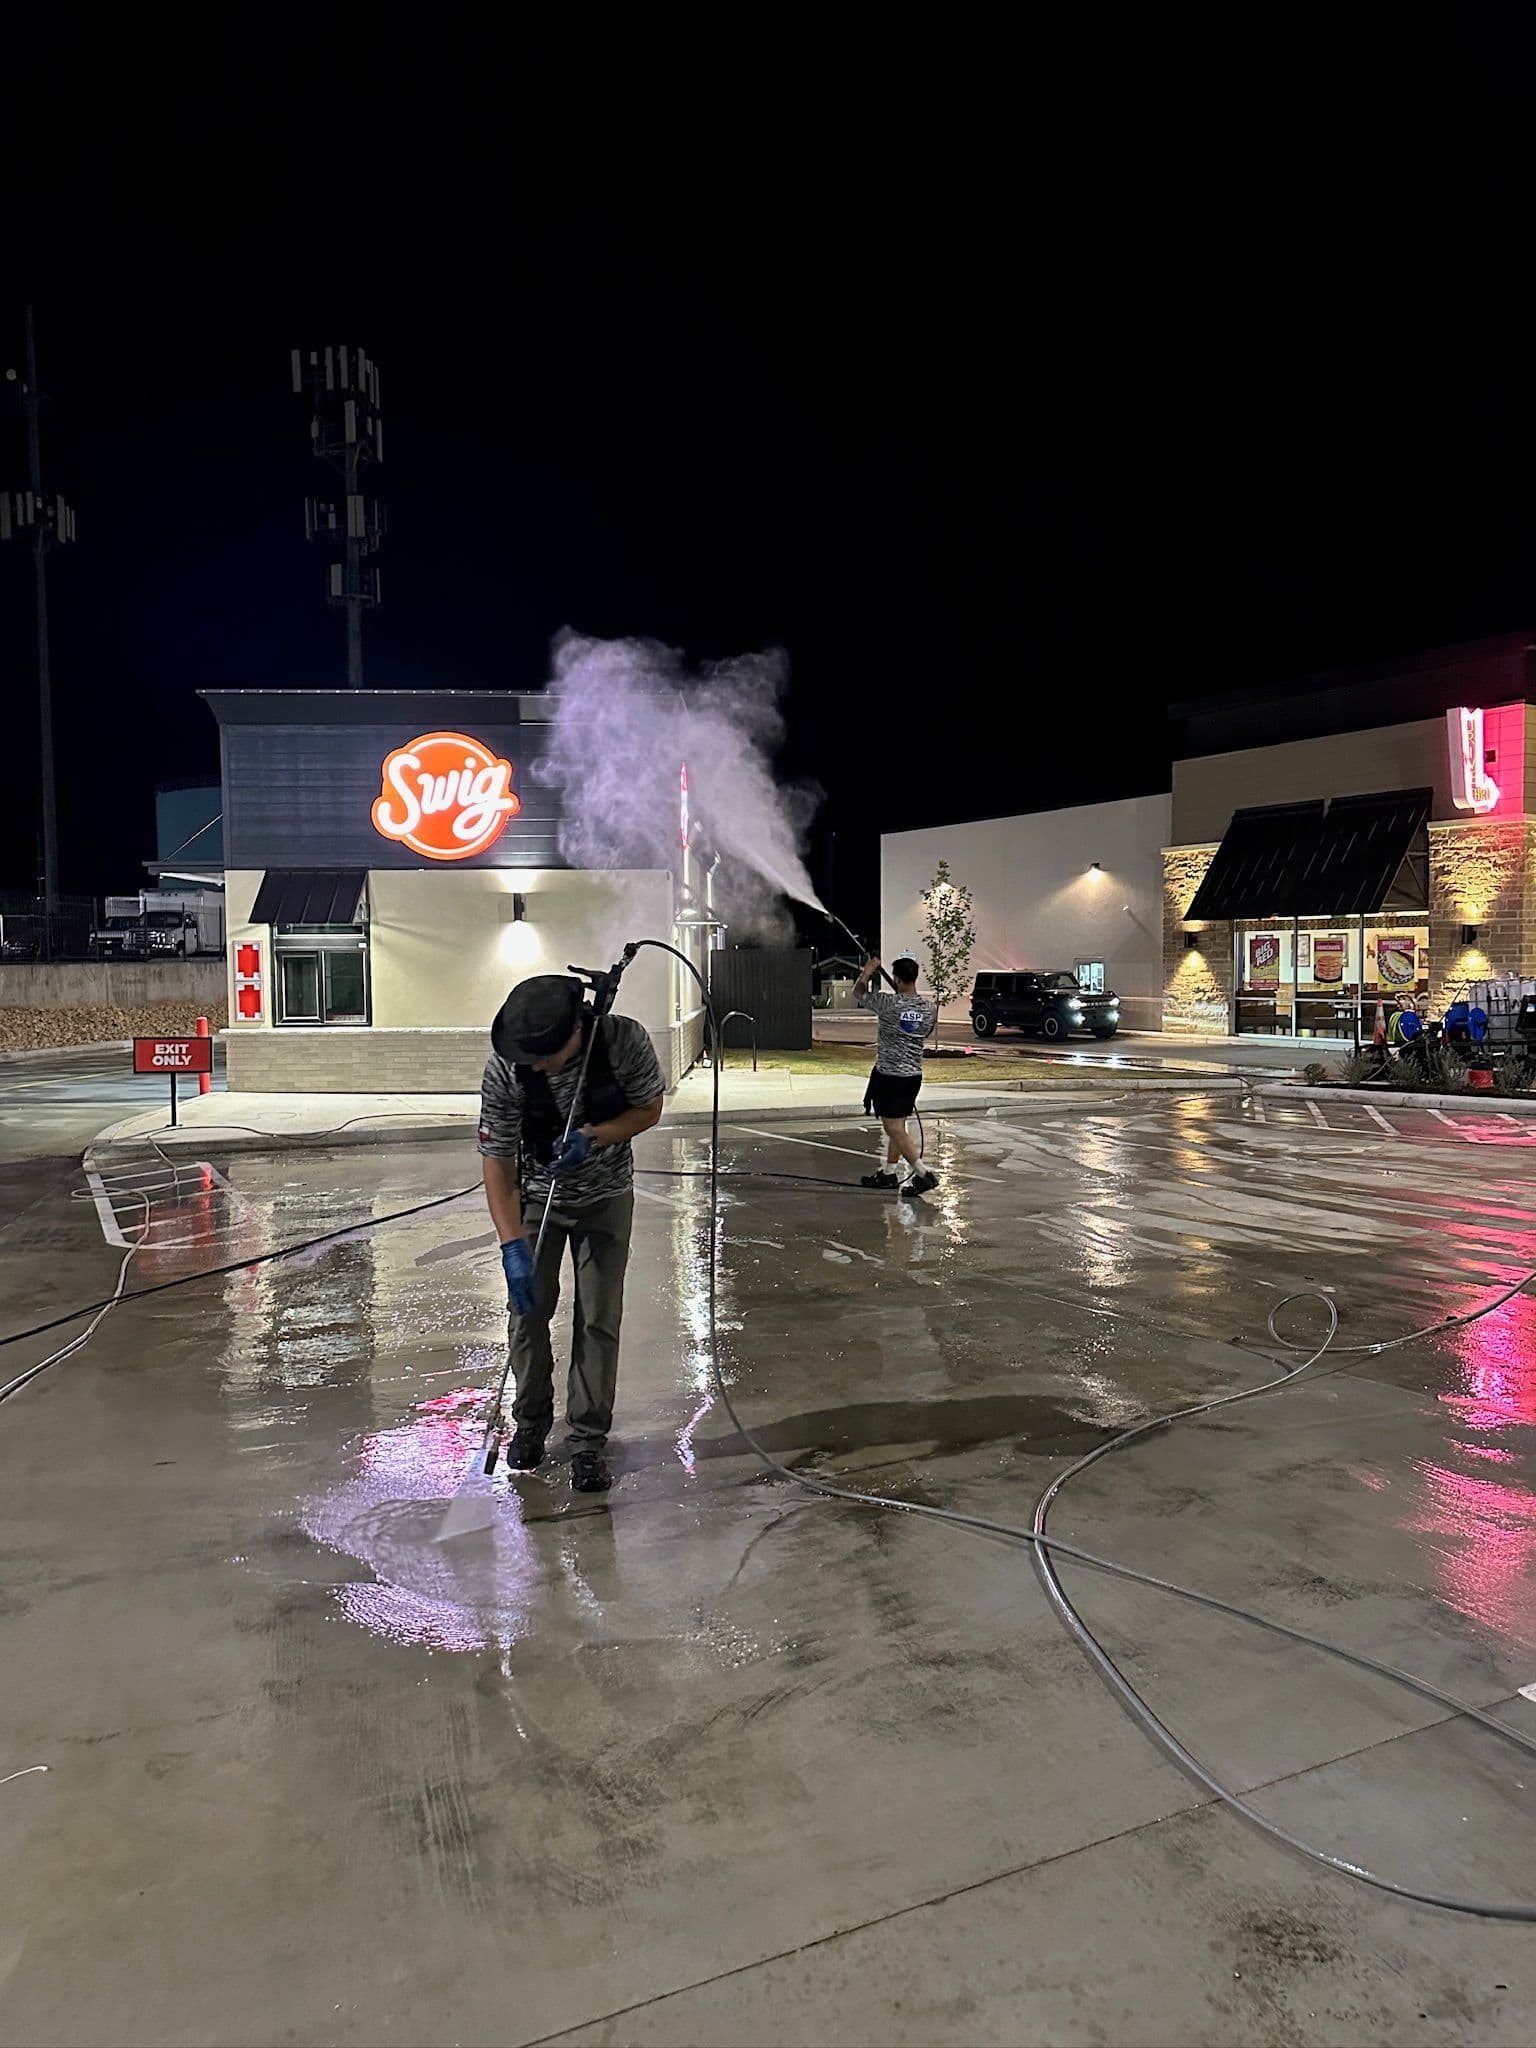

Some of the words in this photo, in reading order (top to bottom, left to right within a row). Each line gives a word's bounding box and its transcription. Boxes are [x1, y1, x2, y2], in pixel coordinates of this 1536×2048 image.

[377, 753, 514, 841] Swig
[1255, 940, 1270, 958] BIG
[1256, 947, 1274, 967] RED
[902, 1012, 922, 1020] ASP
[155, 1043, 189, 1054] EXIT
[152, 1055, 192, 1066] ONLY
